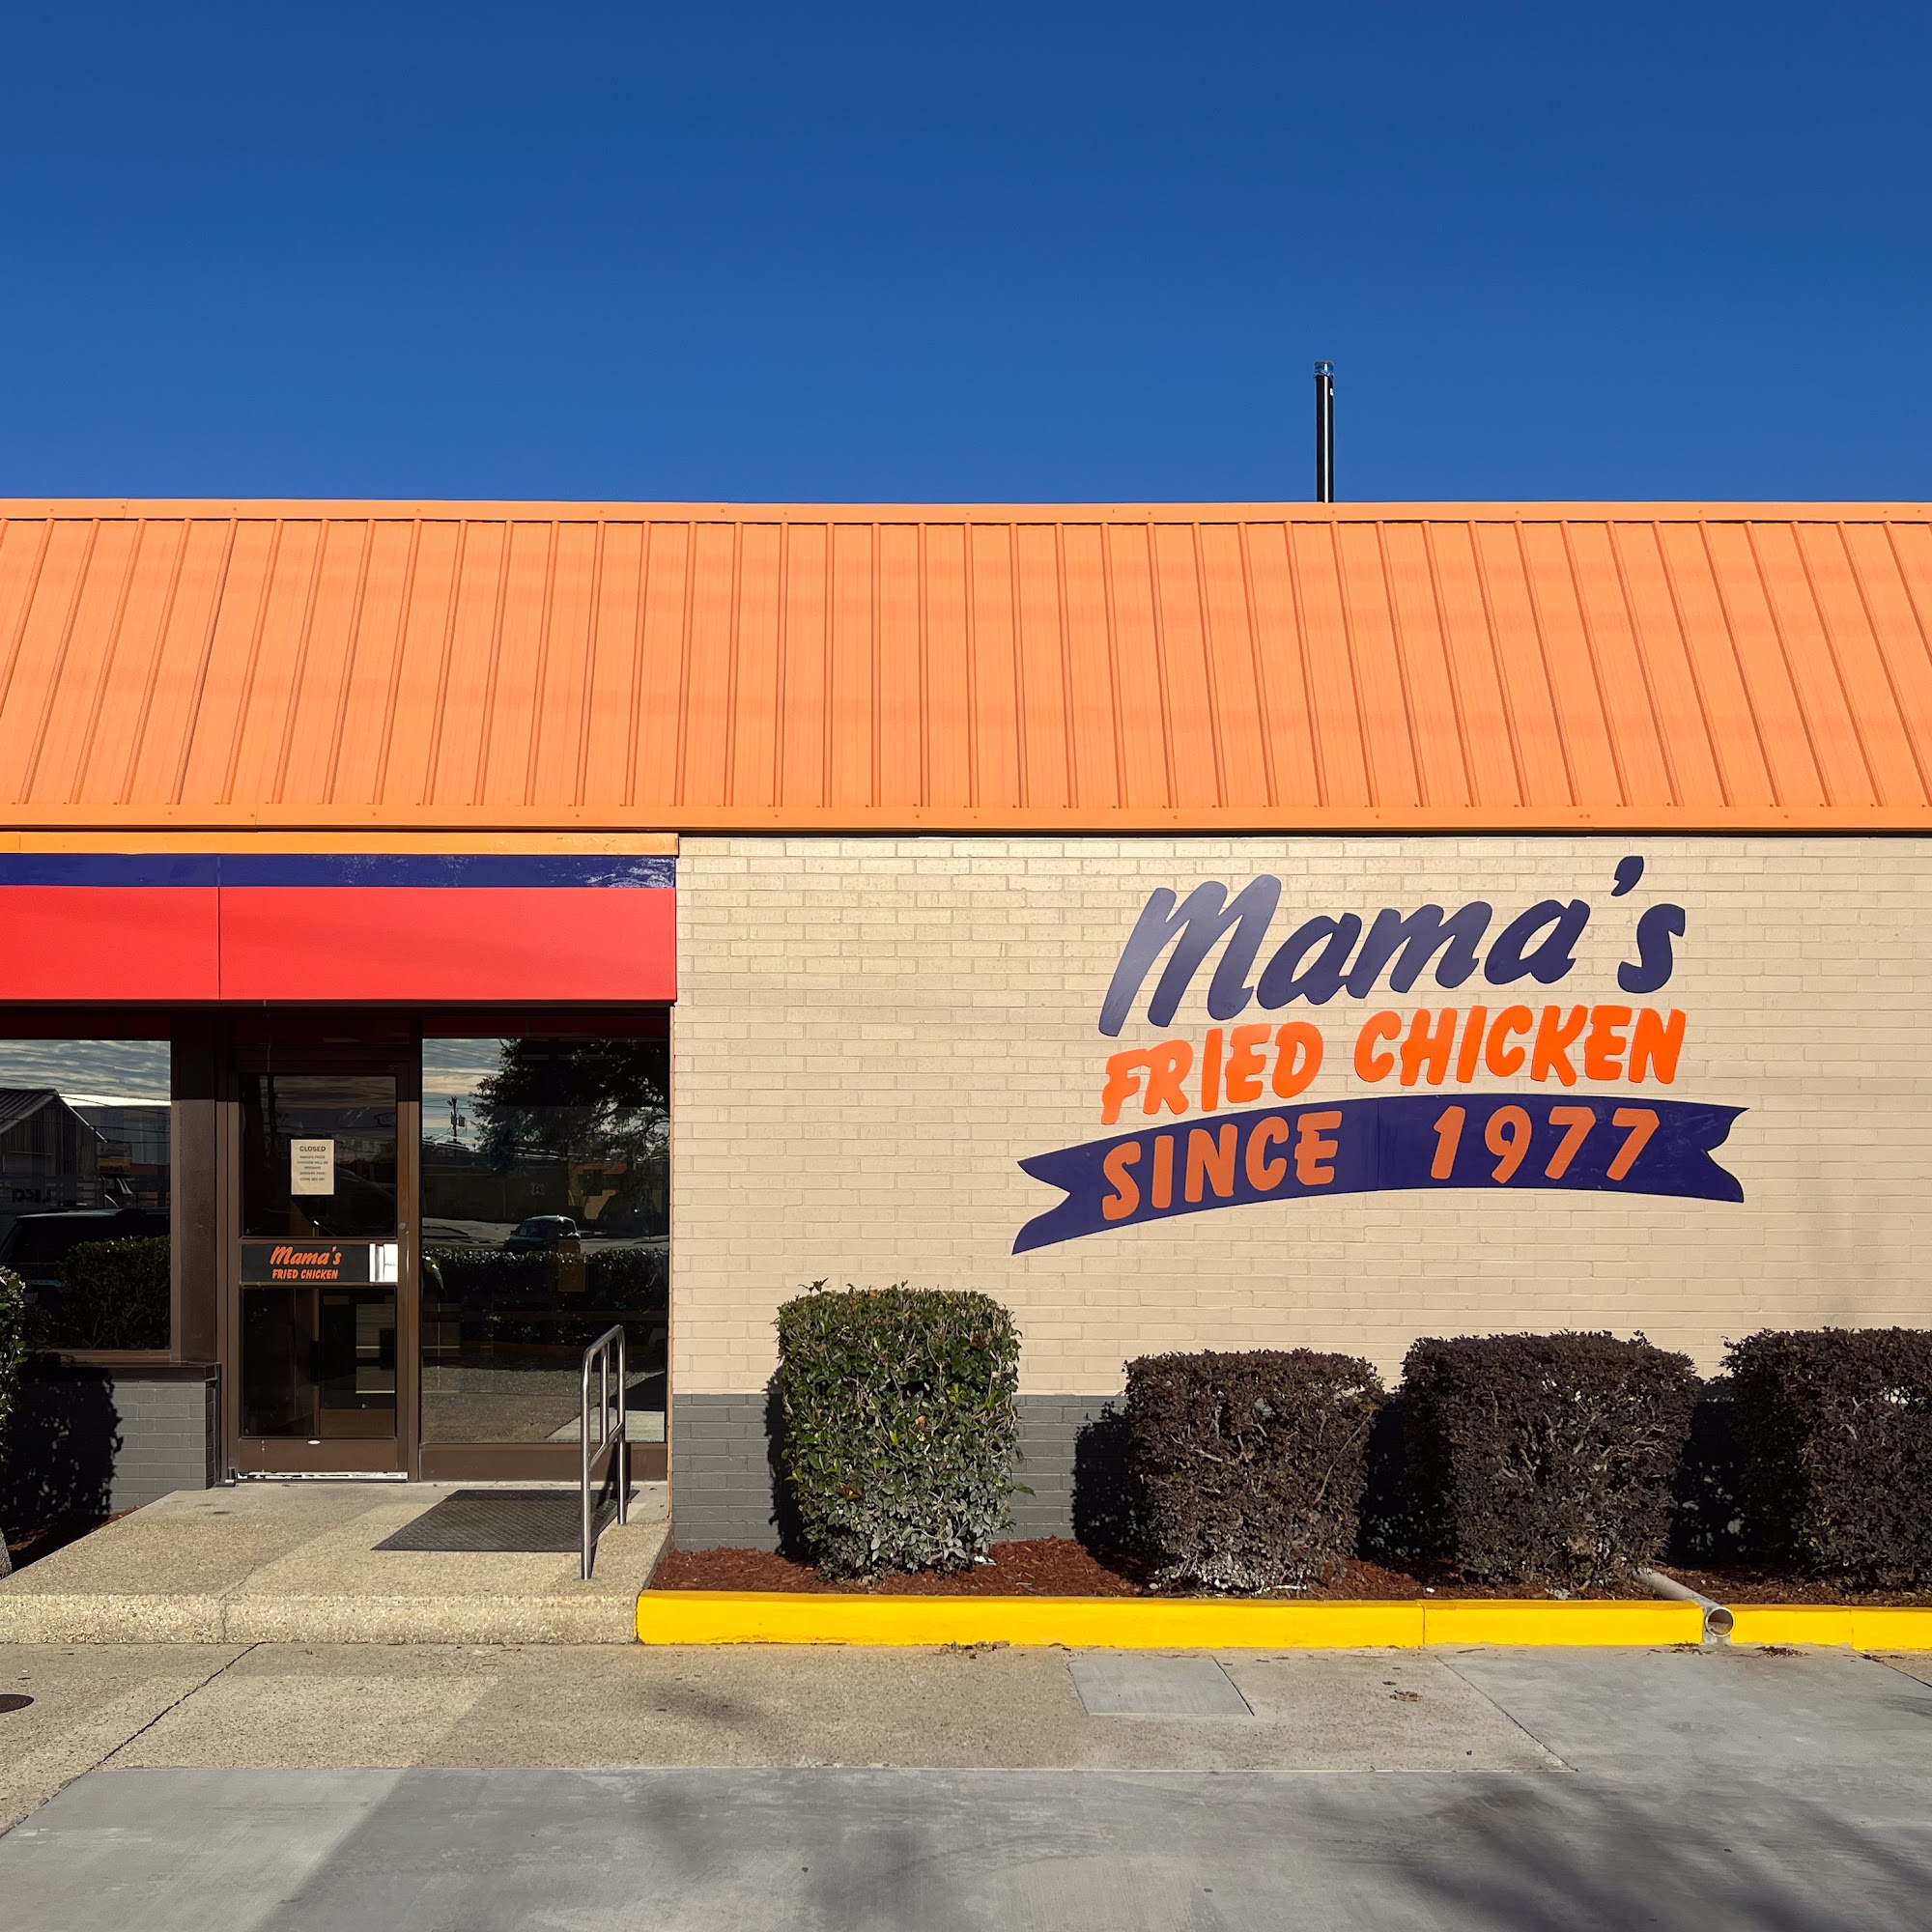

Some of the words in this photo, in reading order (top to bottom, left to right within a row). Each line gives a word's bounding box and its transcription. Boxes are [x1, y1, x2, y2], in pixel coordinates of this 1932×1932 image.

[1098, 856, 1685, 1037] Mama's
[1101, 1021, 1323, 1125] FRIED
[1354, 1005, 1686, 1087] CHICKEN
[1101, 1110, 1343, 1220] SINCE
[1431, 1105, 1660, 1184] 1977
[270, 1245, 342, 1265] Mama's
[271, 1268, 298, 1280] FRIED
[300, 1268, 339, 1280] CHICKEN
